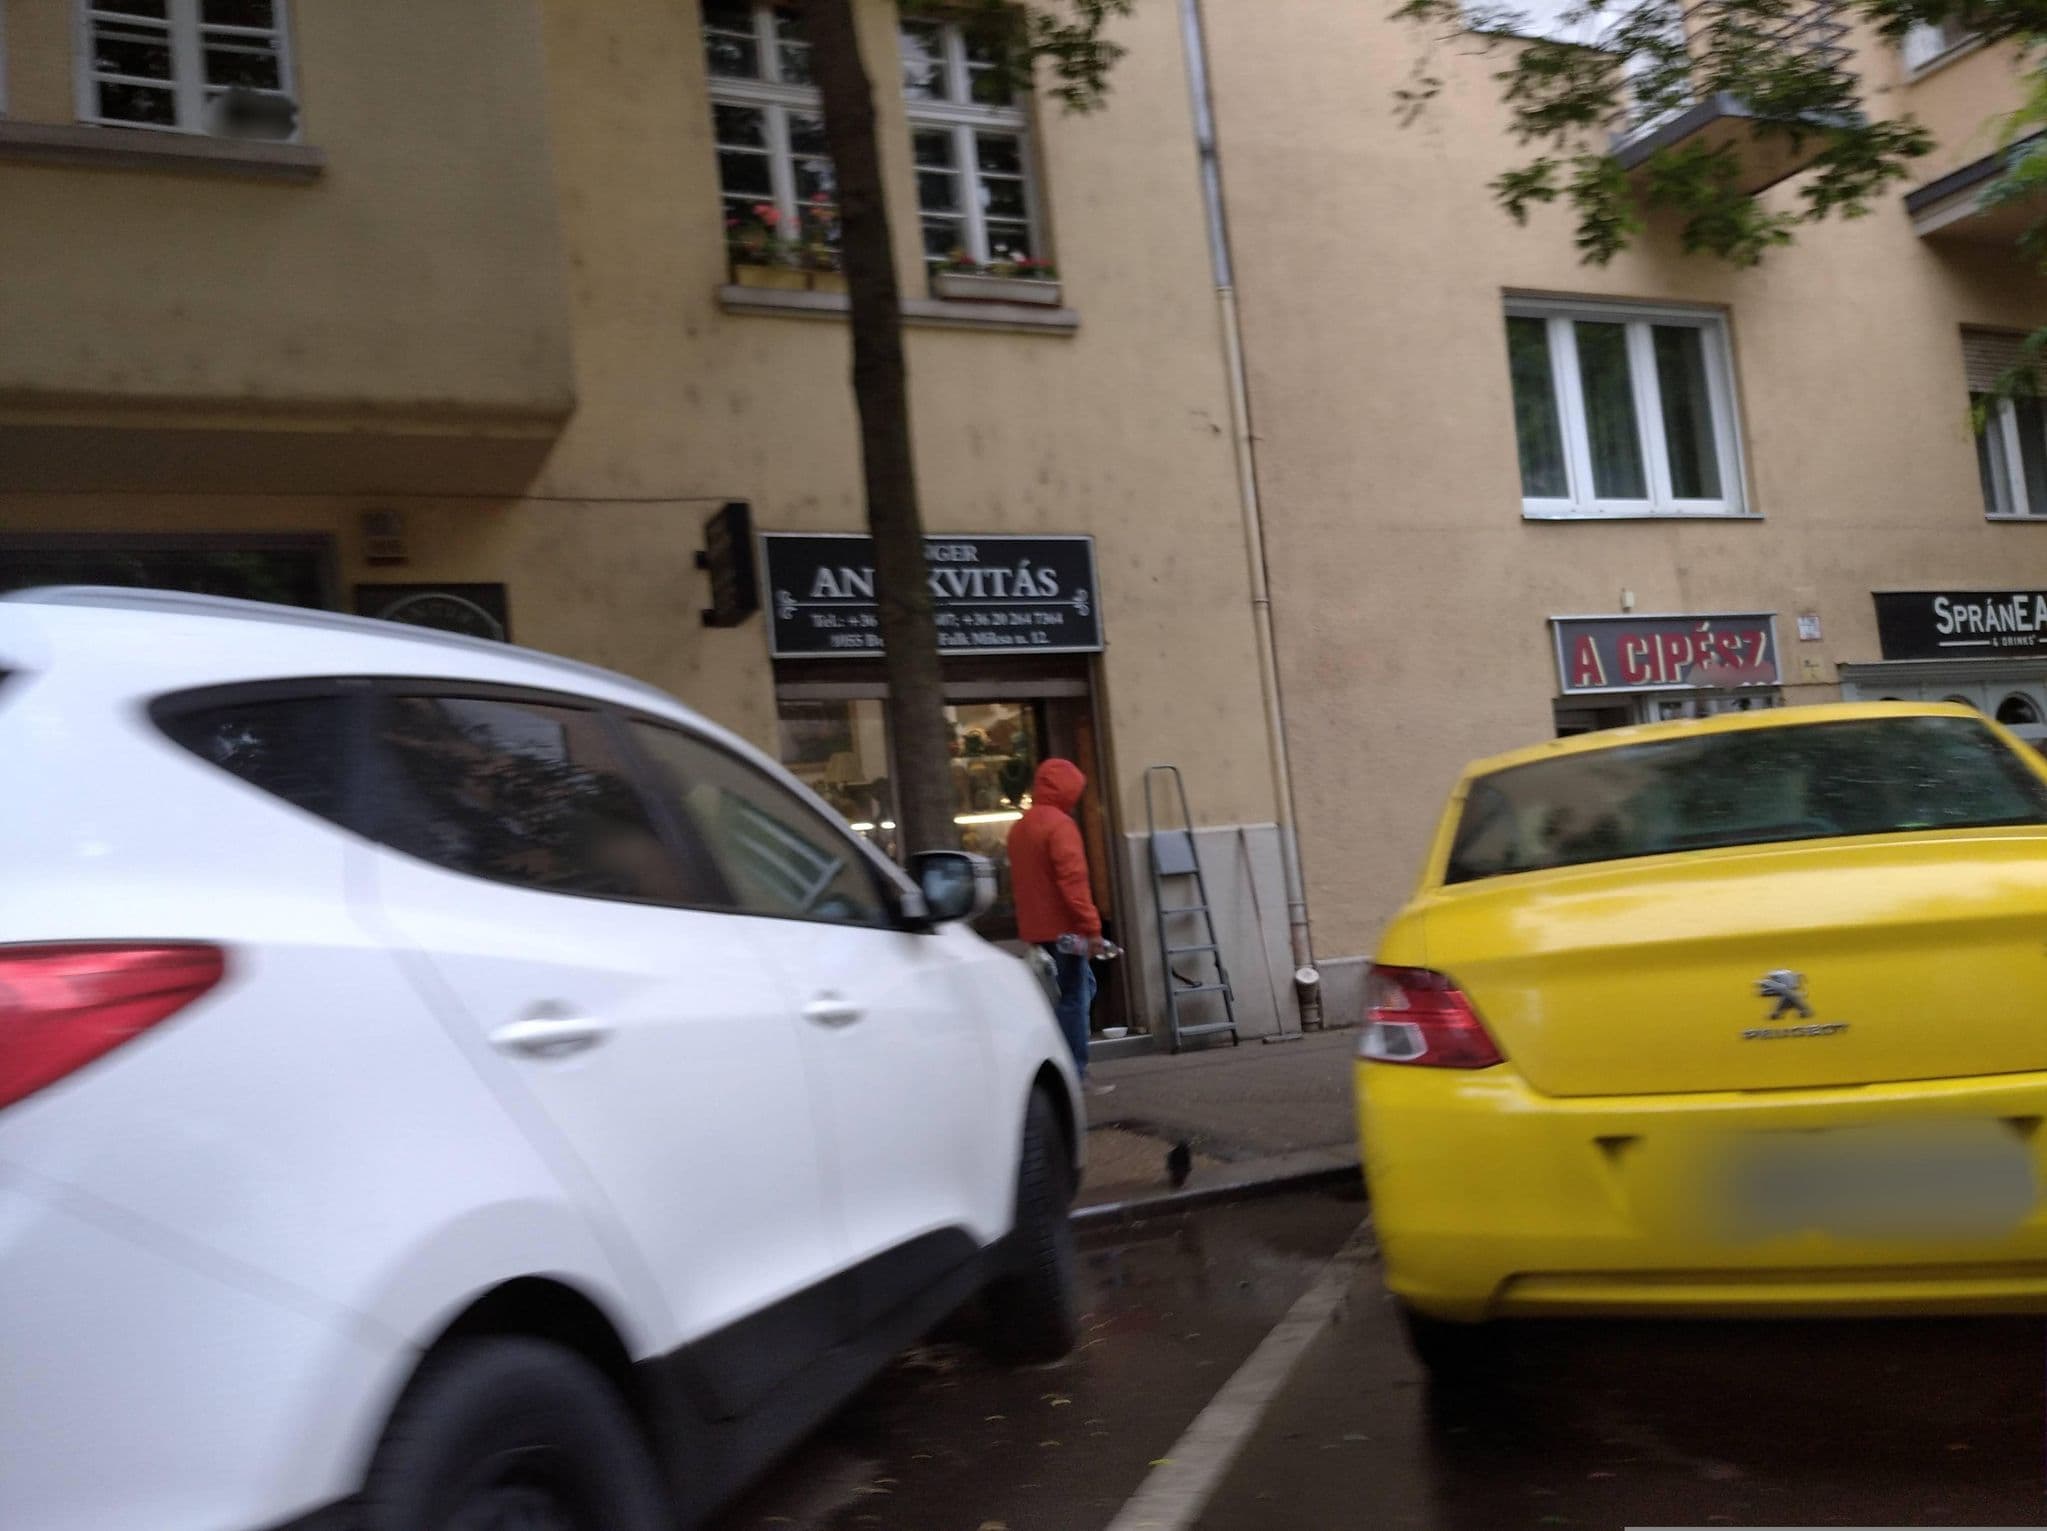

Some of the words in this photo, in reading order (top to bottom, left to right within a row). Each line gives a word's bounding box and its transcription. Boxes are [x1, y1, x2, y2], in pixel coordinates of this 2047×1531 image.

[808, 559, 1060, 597] ANKVITÁS
[1571, 633, 1607, 688] A
[1617, 621, 1766, 685] CIPÉSZ
